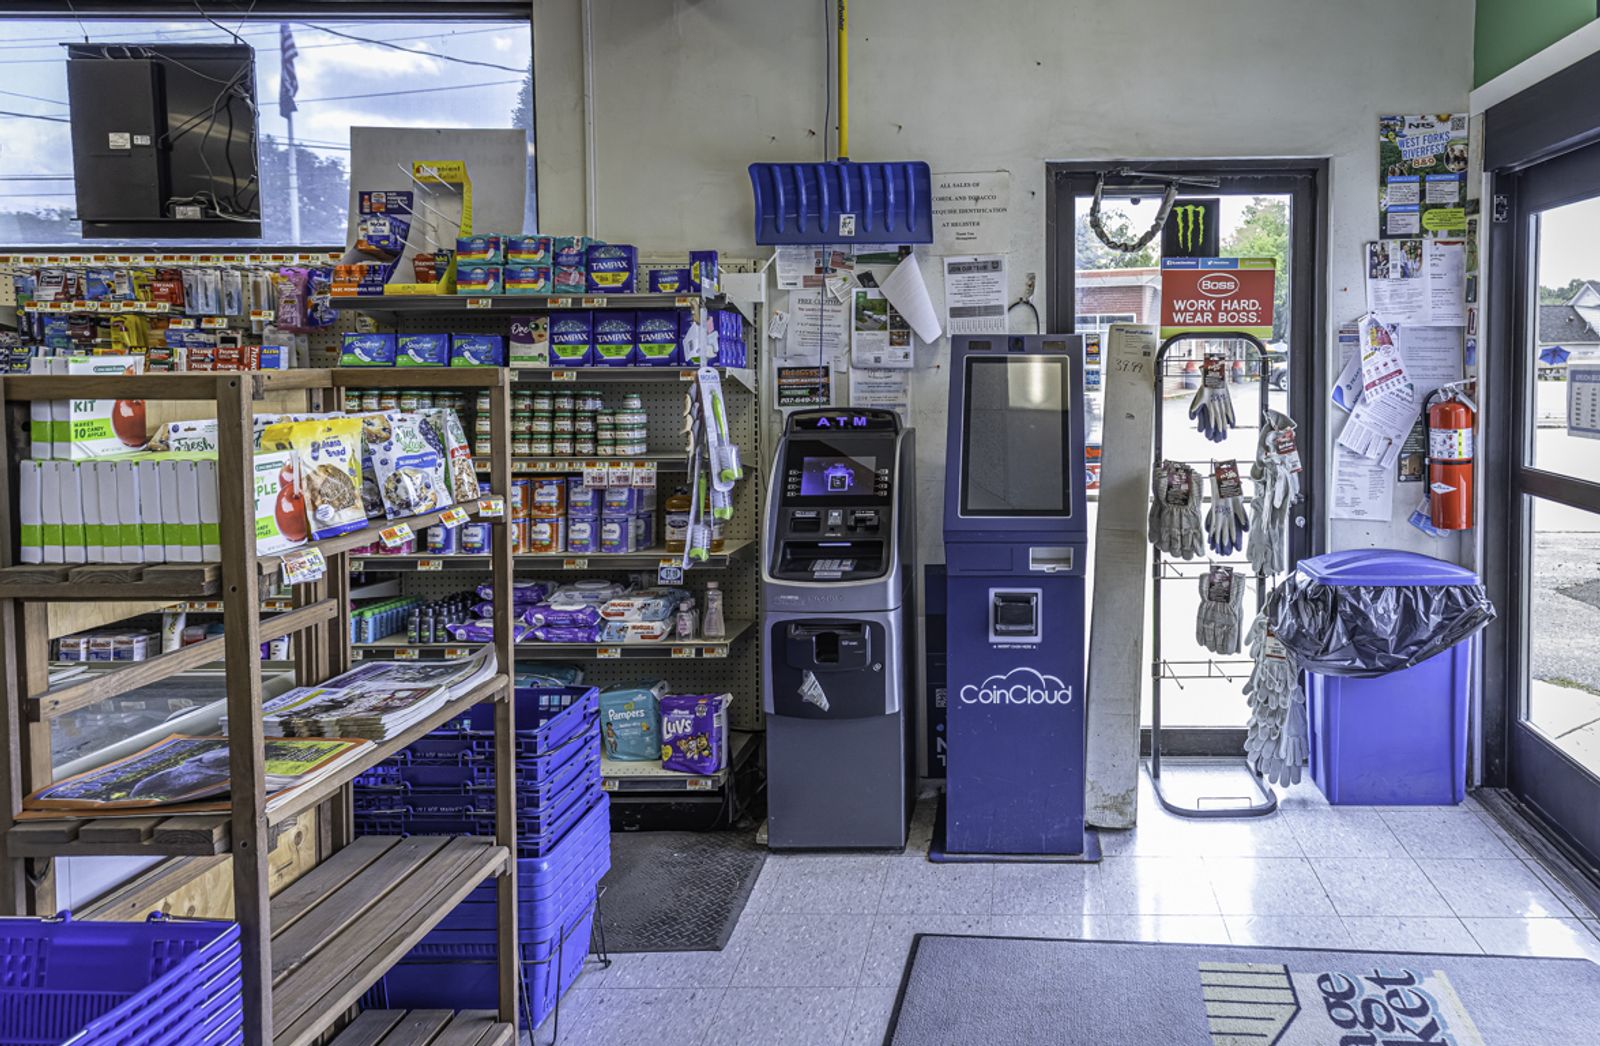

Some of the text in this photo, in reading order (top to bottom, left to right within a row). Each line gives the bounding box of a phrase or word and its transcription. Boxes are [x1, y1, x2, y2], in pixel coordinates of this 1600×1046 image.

[1398, 131, 1451, 149] WEST FORKS
[1401, 143, 1446, 159] RIVERFEST
[592, 260, 628, 271] TAMPAX
[1173, 299, 1262, 311] WORK HARD.
[1172, 312, 1261, 324] WEAR BOSS.
[512, 322, 529, 334] One
[552, 333, 589, 342] TAMPAX
[596, 332, 633, 342] TAMPAX
[639, 332, 675, 342] TAMPAX
[74, 401, 96, 412] KIT
[817, 416, 867, 427] ATM
[74, 428, 86, 439] 10
[174, 437, 216, 451] Fresh
[257, 483, 278, 497] PLE
[960, 685, 1072, 704] CoinCloud
[608, 709, 646, 721] Pampers
